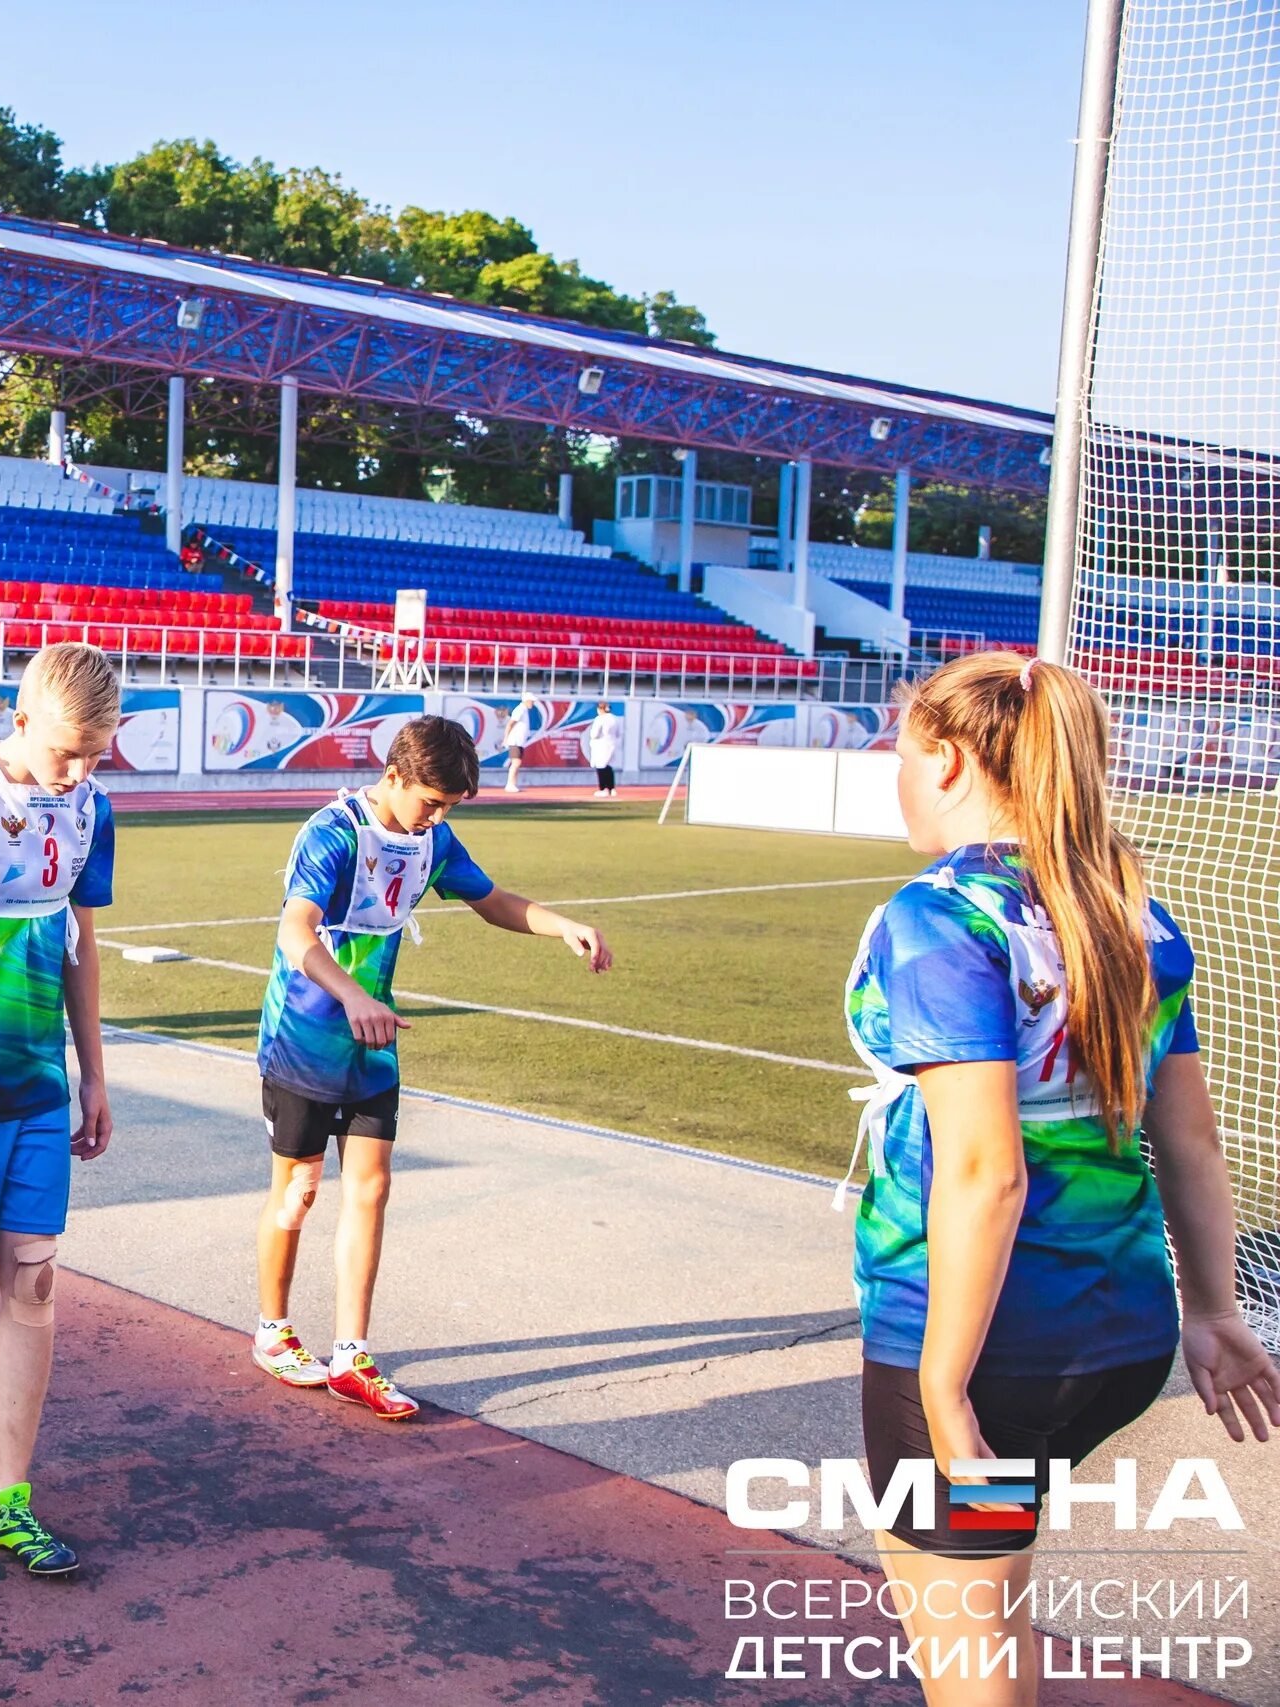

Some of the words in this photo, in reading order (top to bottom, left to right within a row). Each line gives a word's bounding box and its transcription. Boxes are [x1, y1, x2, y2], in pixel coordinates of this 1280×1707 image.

[42, 838, 59, 887] 3
[385, 877, 403, 917] 4
[335, 1342, 357, 1350] ILA
